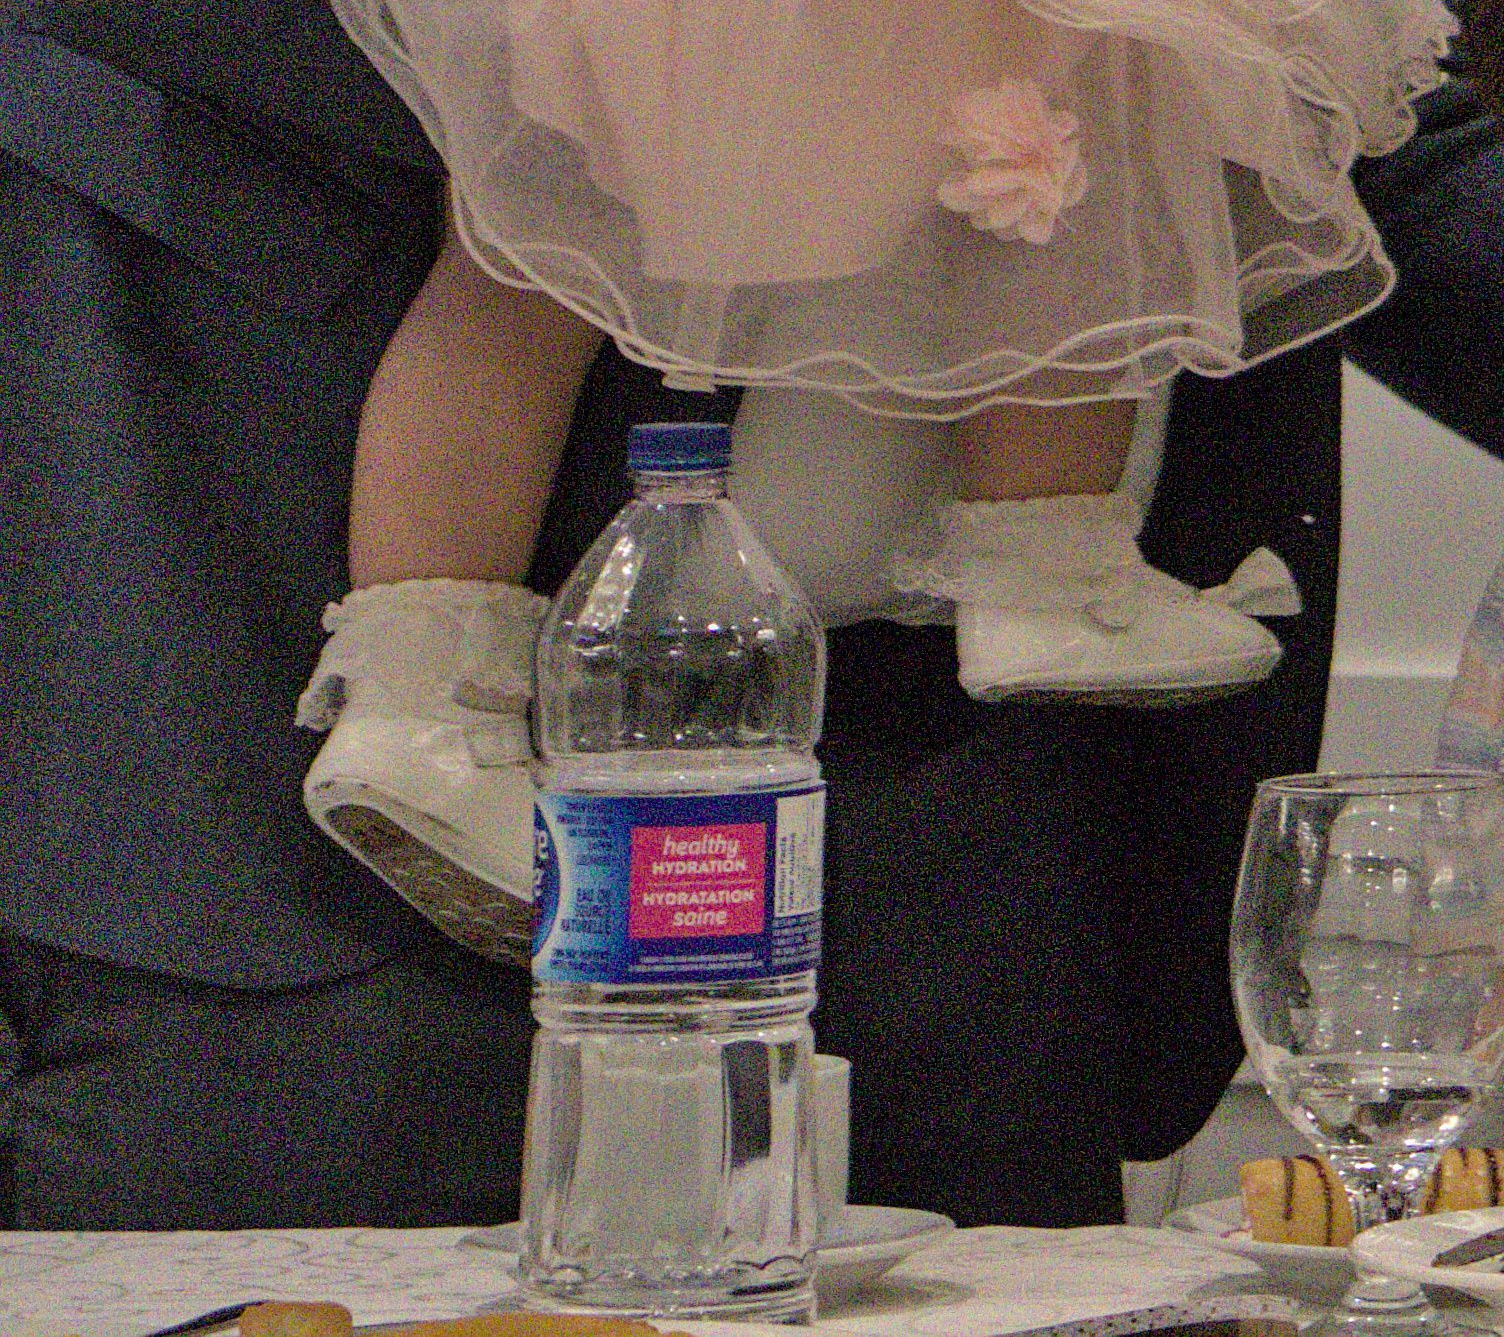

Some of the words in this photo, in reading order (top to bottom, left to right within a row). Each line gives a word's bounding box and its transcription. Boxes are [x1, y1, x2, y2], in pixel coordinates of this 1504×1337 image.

[663, 834, 740, 859] healthy
[652, 859, 747, 876] HYDRATION
[643, 888, 755, 907] HYDRATATION
[672, 905, 728, 927] saine
